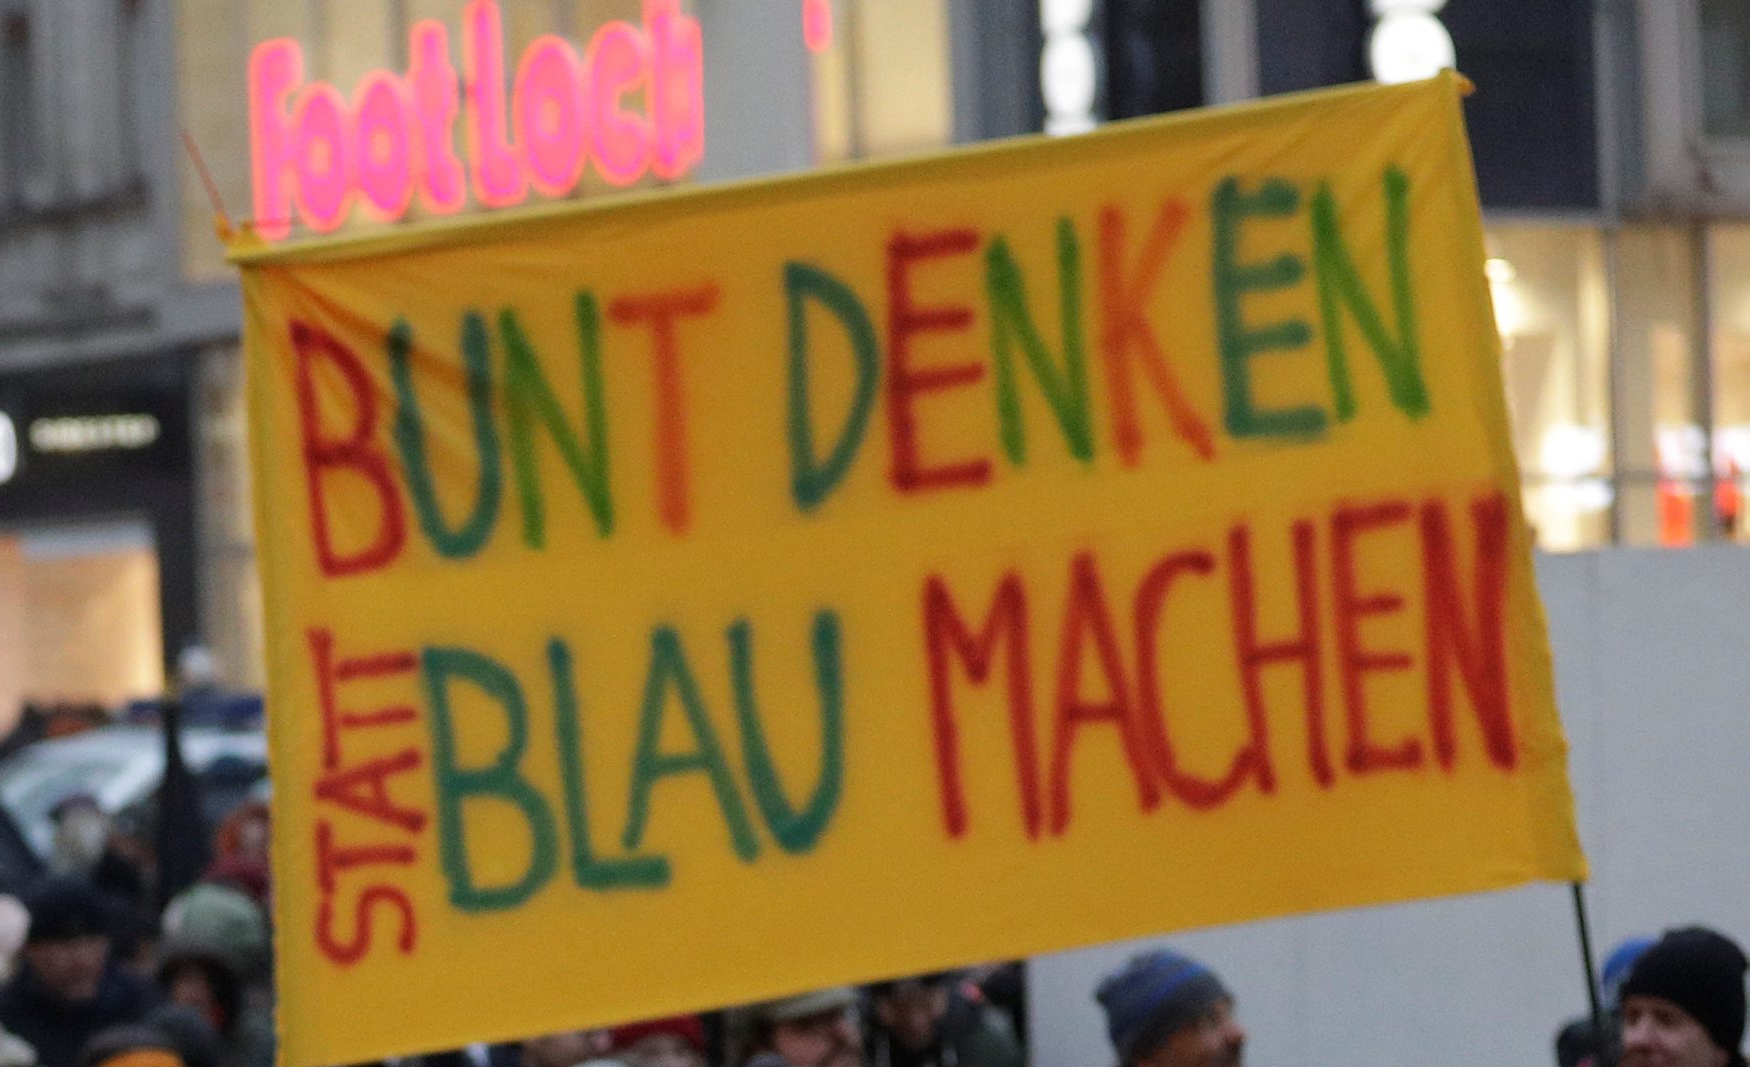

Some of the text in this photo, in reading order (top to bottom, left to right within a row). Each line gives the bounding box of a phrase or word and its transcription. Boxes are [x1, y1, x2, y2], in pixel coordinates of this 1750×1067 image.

[290, 164, 1431, 580] BUNT DENKEN
[306, 626, 427, 968] STATT
[421, 492, 1521, 913] BLAU MACHEN
